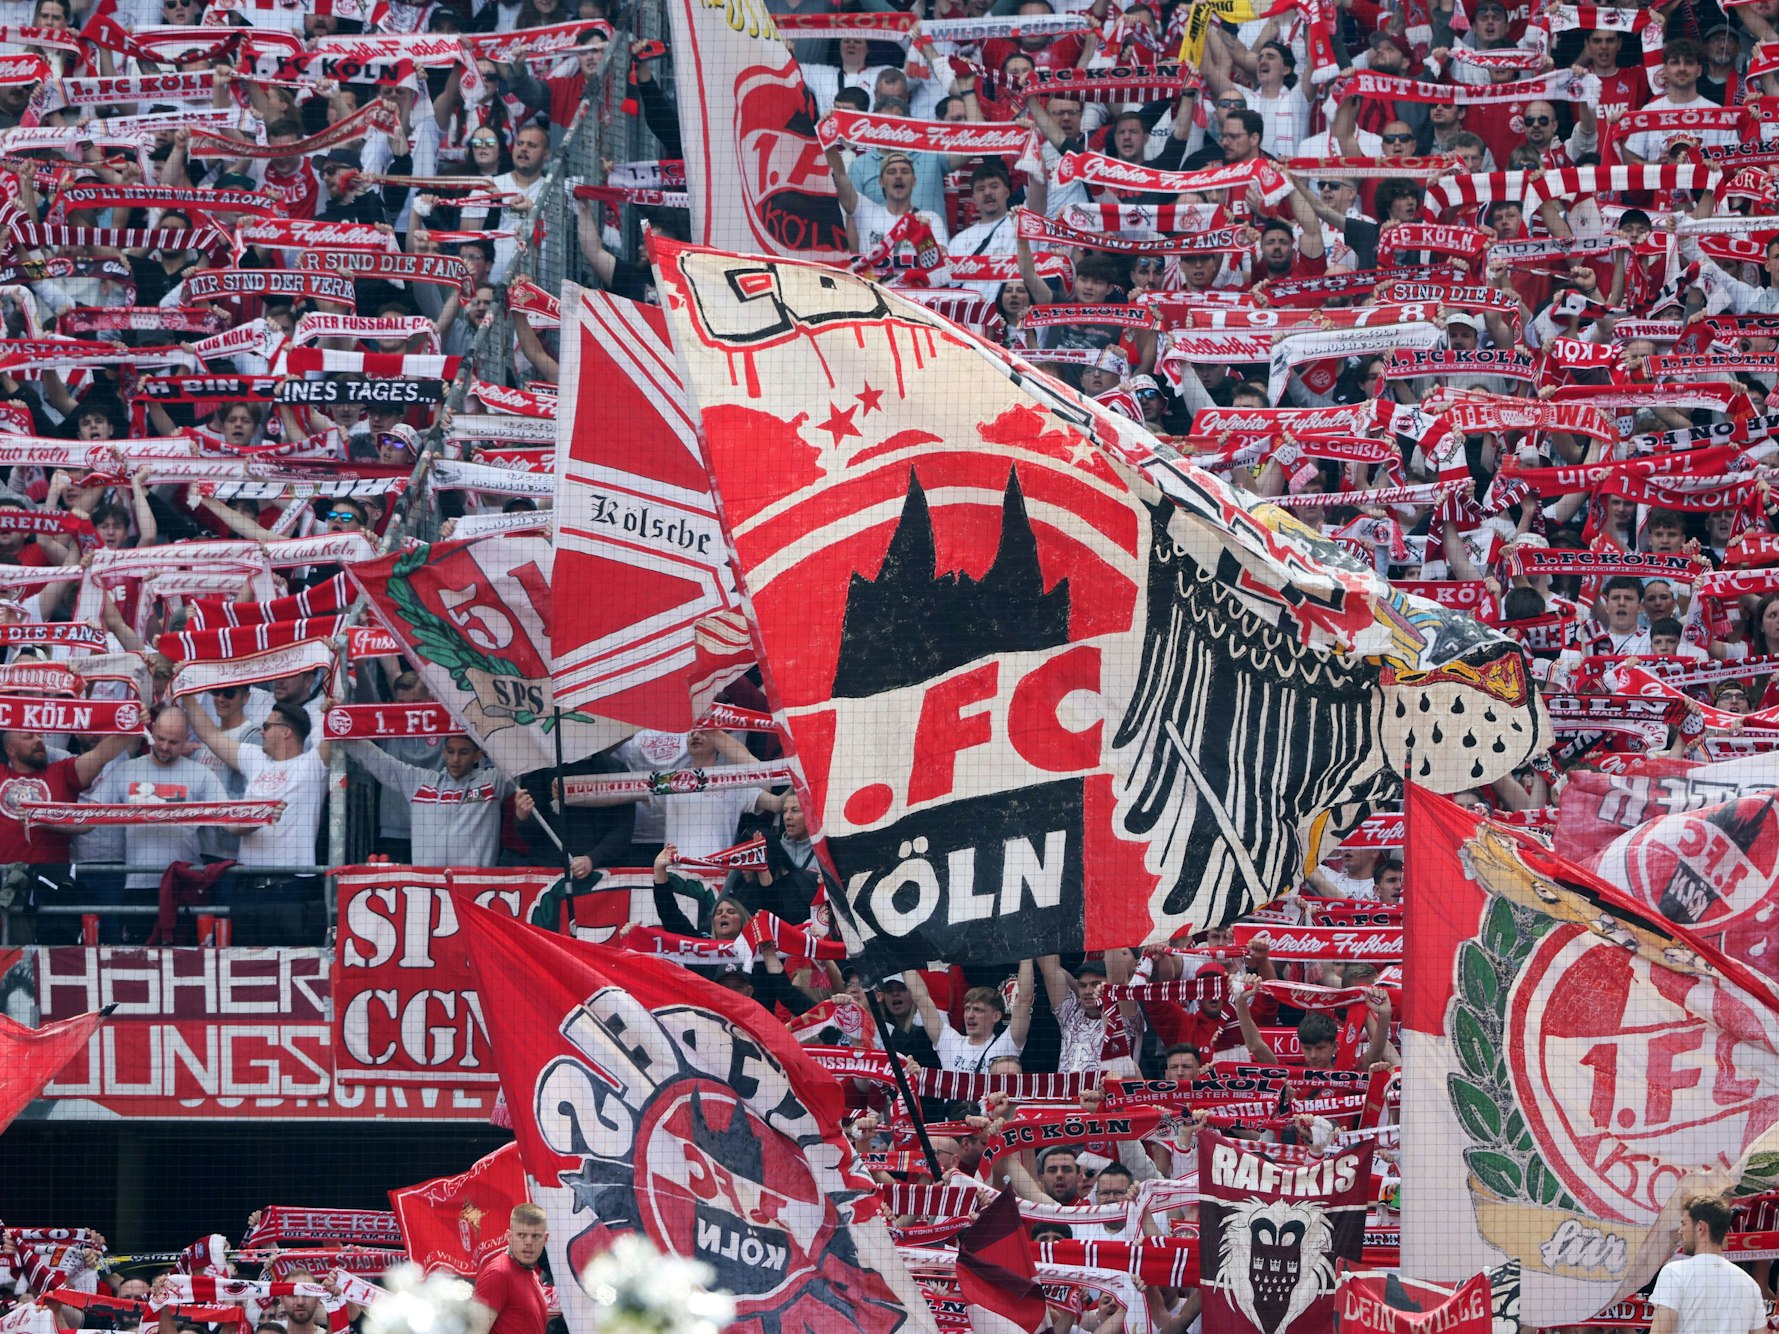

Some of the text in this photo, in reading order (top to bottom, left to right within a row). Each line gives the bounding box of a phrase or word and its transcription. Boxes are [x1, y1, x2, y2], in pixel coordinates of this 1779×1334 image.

[829, 12, 914, 31] KÖLN
[930, 19, 1092, 42] WILDER SÜDEN
[245, 54, 398, 82] 1. FC KÖLN
[1037, 67, 1074, 83] FC
[98, 78, 131, 95] FC
[1357, 74, 1548, 100] RUT UN WIESS
[1658, 108, 1742, 126] KÖLN
[64, 186, 275, 210] YOU'LL NEVER WALK ALONE
[1180, 229, 1234, 249] FANS
[1421, 226, 1475, 250] KÖLN
[323, 254, 376, 274] SIND
[379, 255, 418, 275] DIE
[188, 274, 305, 296] WIR SIND DER
[1393, 283, 1490, 304] SIND DIE
[1081, 305, 1146, 320] KÖLN
[222, 327, 254, 347] KÖLN
[1390, 349, 1533, 370] 1. FC KÖLN
[1711, 353, 1777, 369] KÖLN
[1199, 411, 1272, 433] Geliebter
[1643, 487, 1673, 504] FC
[590, 494, 712, 556] Kölsche
[320, 540, 357, 559] Köln
[1558, 553, 1592, 568] FC
[1596, 552, 1690, 571] KÖLN
[1709, 574, 1753, 594] FC
[8, 627, 107, 646] DIE FANS
[491, 679, 544, 715] SPS
[1548, 695, 1671, 715] ÖLN
[22, 701, 93, 730] KÖLN
[375, 710, 438, 735] 1. FC
[844, 829, 1068, 943] KÖLN
[1351, 913, 1389, 926] FC
[652, 936, 710, 959] 1. FC
[40, 946, 333, 1015] HÖHER
[43, 1024, 331, 1097] JUNGS
[1236, 1065, 1289, 1080] FC
[1119, 1080, 1176, 1096] FC
[1171, 1091, 1229, 1101] MEISTER
[1001, 1129, 1035, 1148] FC
[1041, 1117, 1131, 1142] KÖLN
[1211, 1143, 1360, 1198] RAFIKIS
[284, 1230, 381, 1241] DIE MACHT AM
[1342, 1287, 1487, 1334] DEIN WILLE
